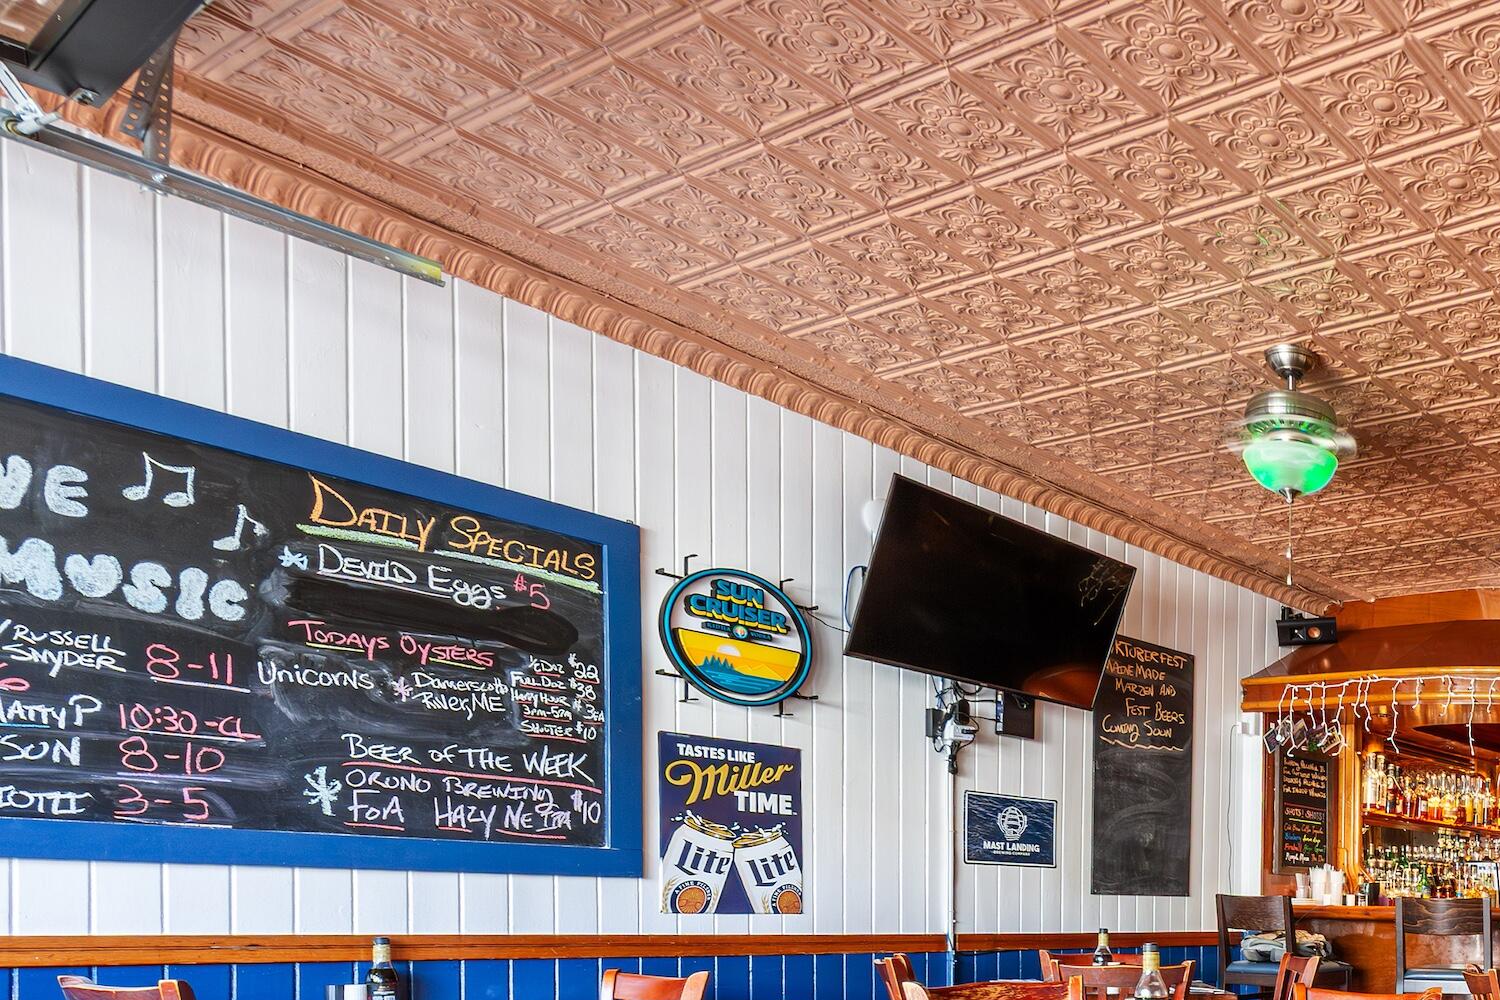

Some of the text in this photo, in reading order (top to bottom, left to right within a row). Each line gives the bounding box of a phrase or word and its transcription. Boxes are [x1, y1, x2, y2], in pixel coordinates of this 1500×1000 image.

[308, 472, 596, 580] DAILY SPECIALS
[0, 535, 248, 622] MUSIC
[428, 564, 507, 610] Eggs
[716, 579, 764, 609] SUN
[689, 593, 788, 634] CRUISER
[12, 624, 127, 656] RUSSELL
[287, 620, 495, 668] TODAYS OYSTERS
[1, 643, 127, 678] SNYDER
[1135, 662, 1166, 681] MADE
[1160, 683, 1176, 697] AND
[1125, 697, 1185, 724] FEST BEERS
[1143, 720, 1172, 738] SOON
[119, 736, 226, 776] 8-10
[341, 733, 421, 765] BEER
[458, 747, 513, 772] THE
[522, 745, 595, 786] WEEK
[676, 743, 756, 764] TASTES LIKE
[345, 768, 431, 793] ORONO
[665, 759, 794, 806] Miller
[113, 784, 210, 821] 3-5
[434, 796, 497, 840] HAZY
[570, 789, 601, 825] $10
[733, 790, 793, 816] TIME
[674, 839, 733, 876] Lite
[983, 840, 1040, 853] MAST LANDING
[745, 850, 797, 887] Lite
